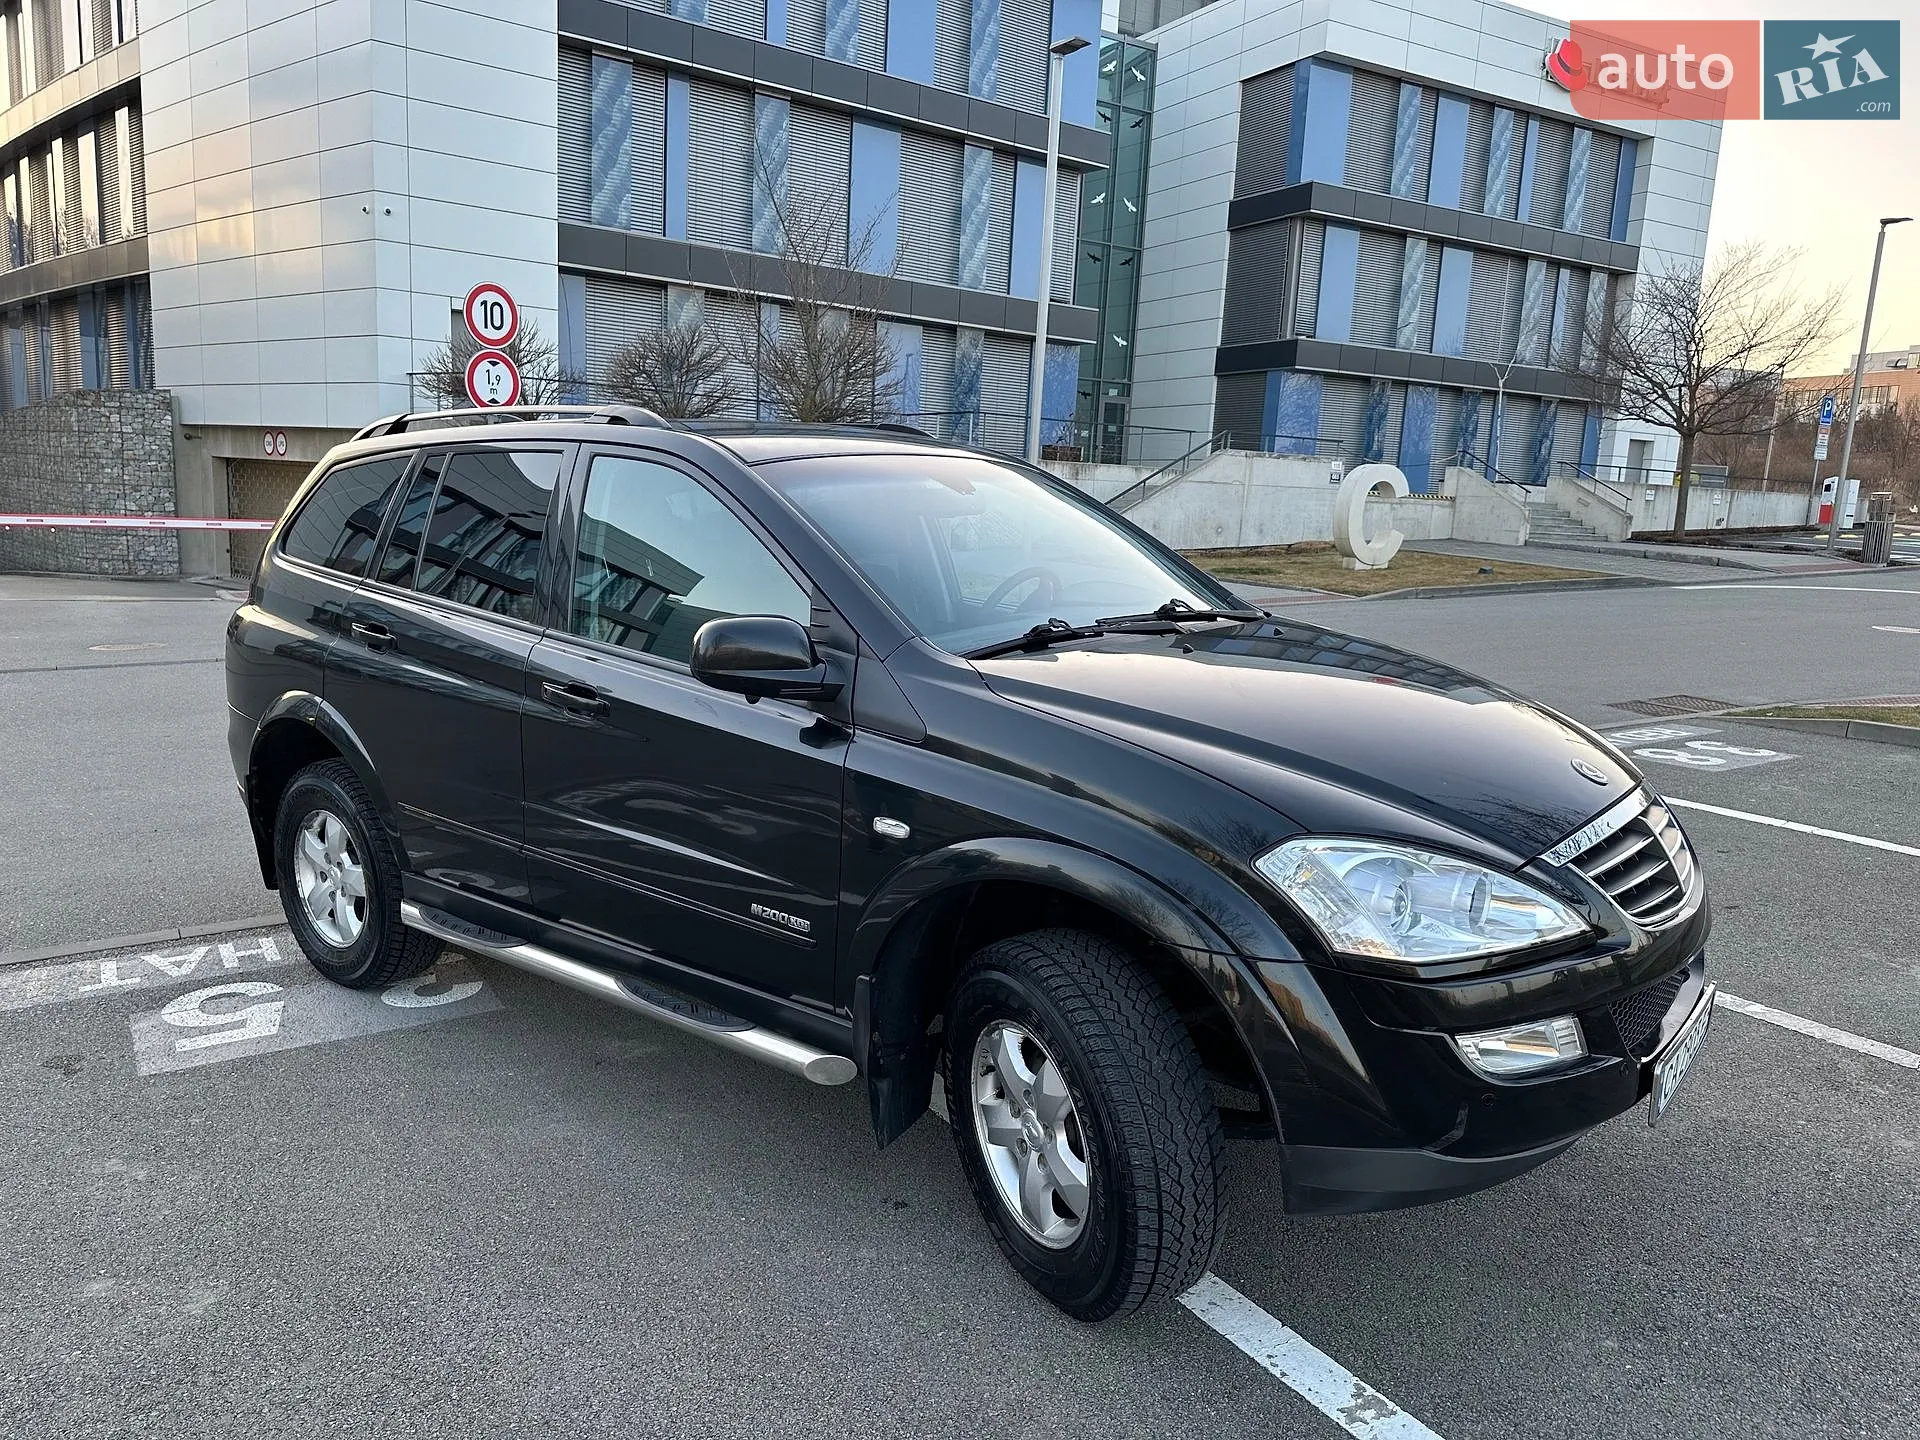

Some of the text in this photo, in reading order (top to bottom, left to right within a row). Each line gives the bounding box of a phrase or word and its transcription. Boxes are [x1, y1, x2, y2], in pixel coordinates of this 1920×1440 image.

[480, 299, 504, 331] 10
[485, 369, 501, 386] 1,9
[490, 387, 498, 396] m
[1824, 399, 1831, 416] P
[1333, 463, 1410, 567] C
[751, 902, 788, 925] M200
[79, 937, 281, 992] HAT
